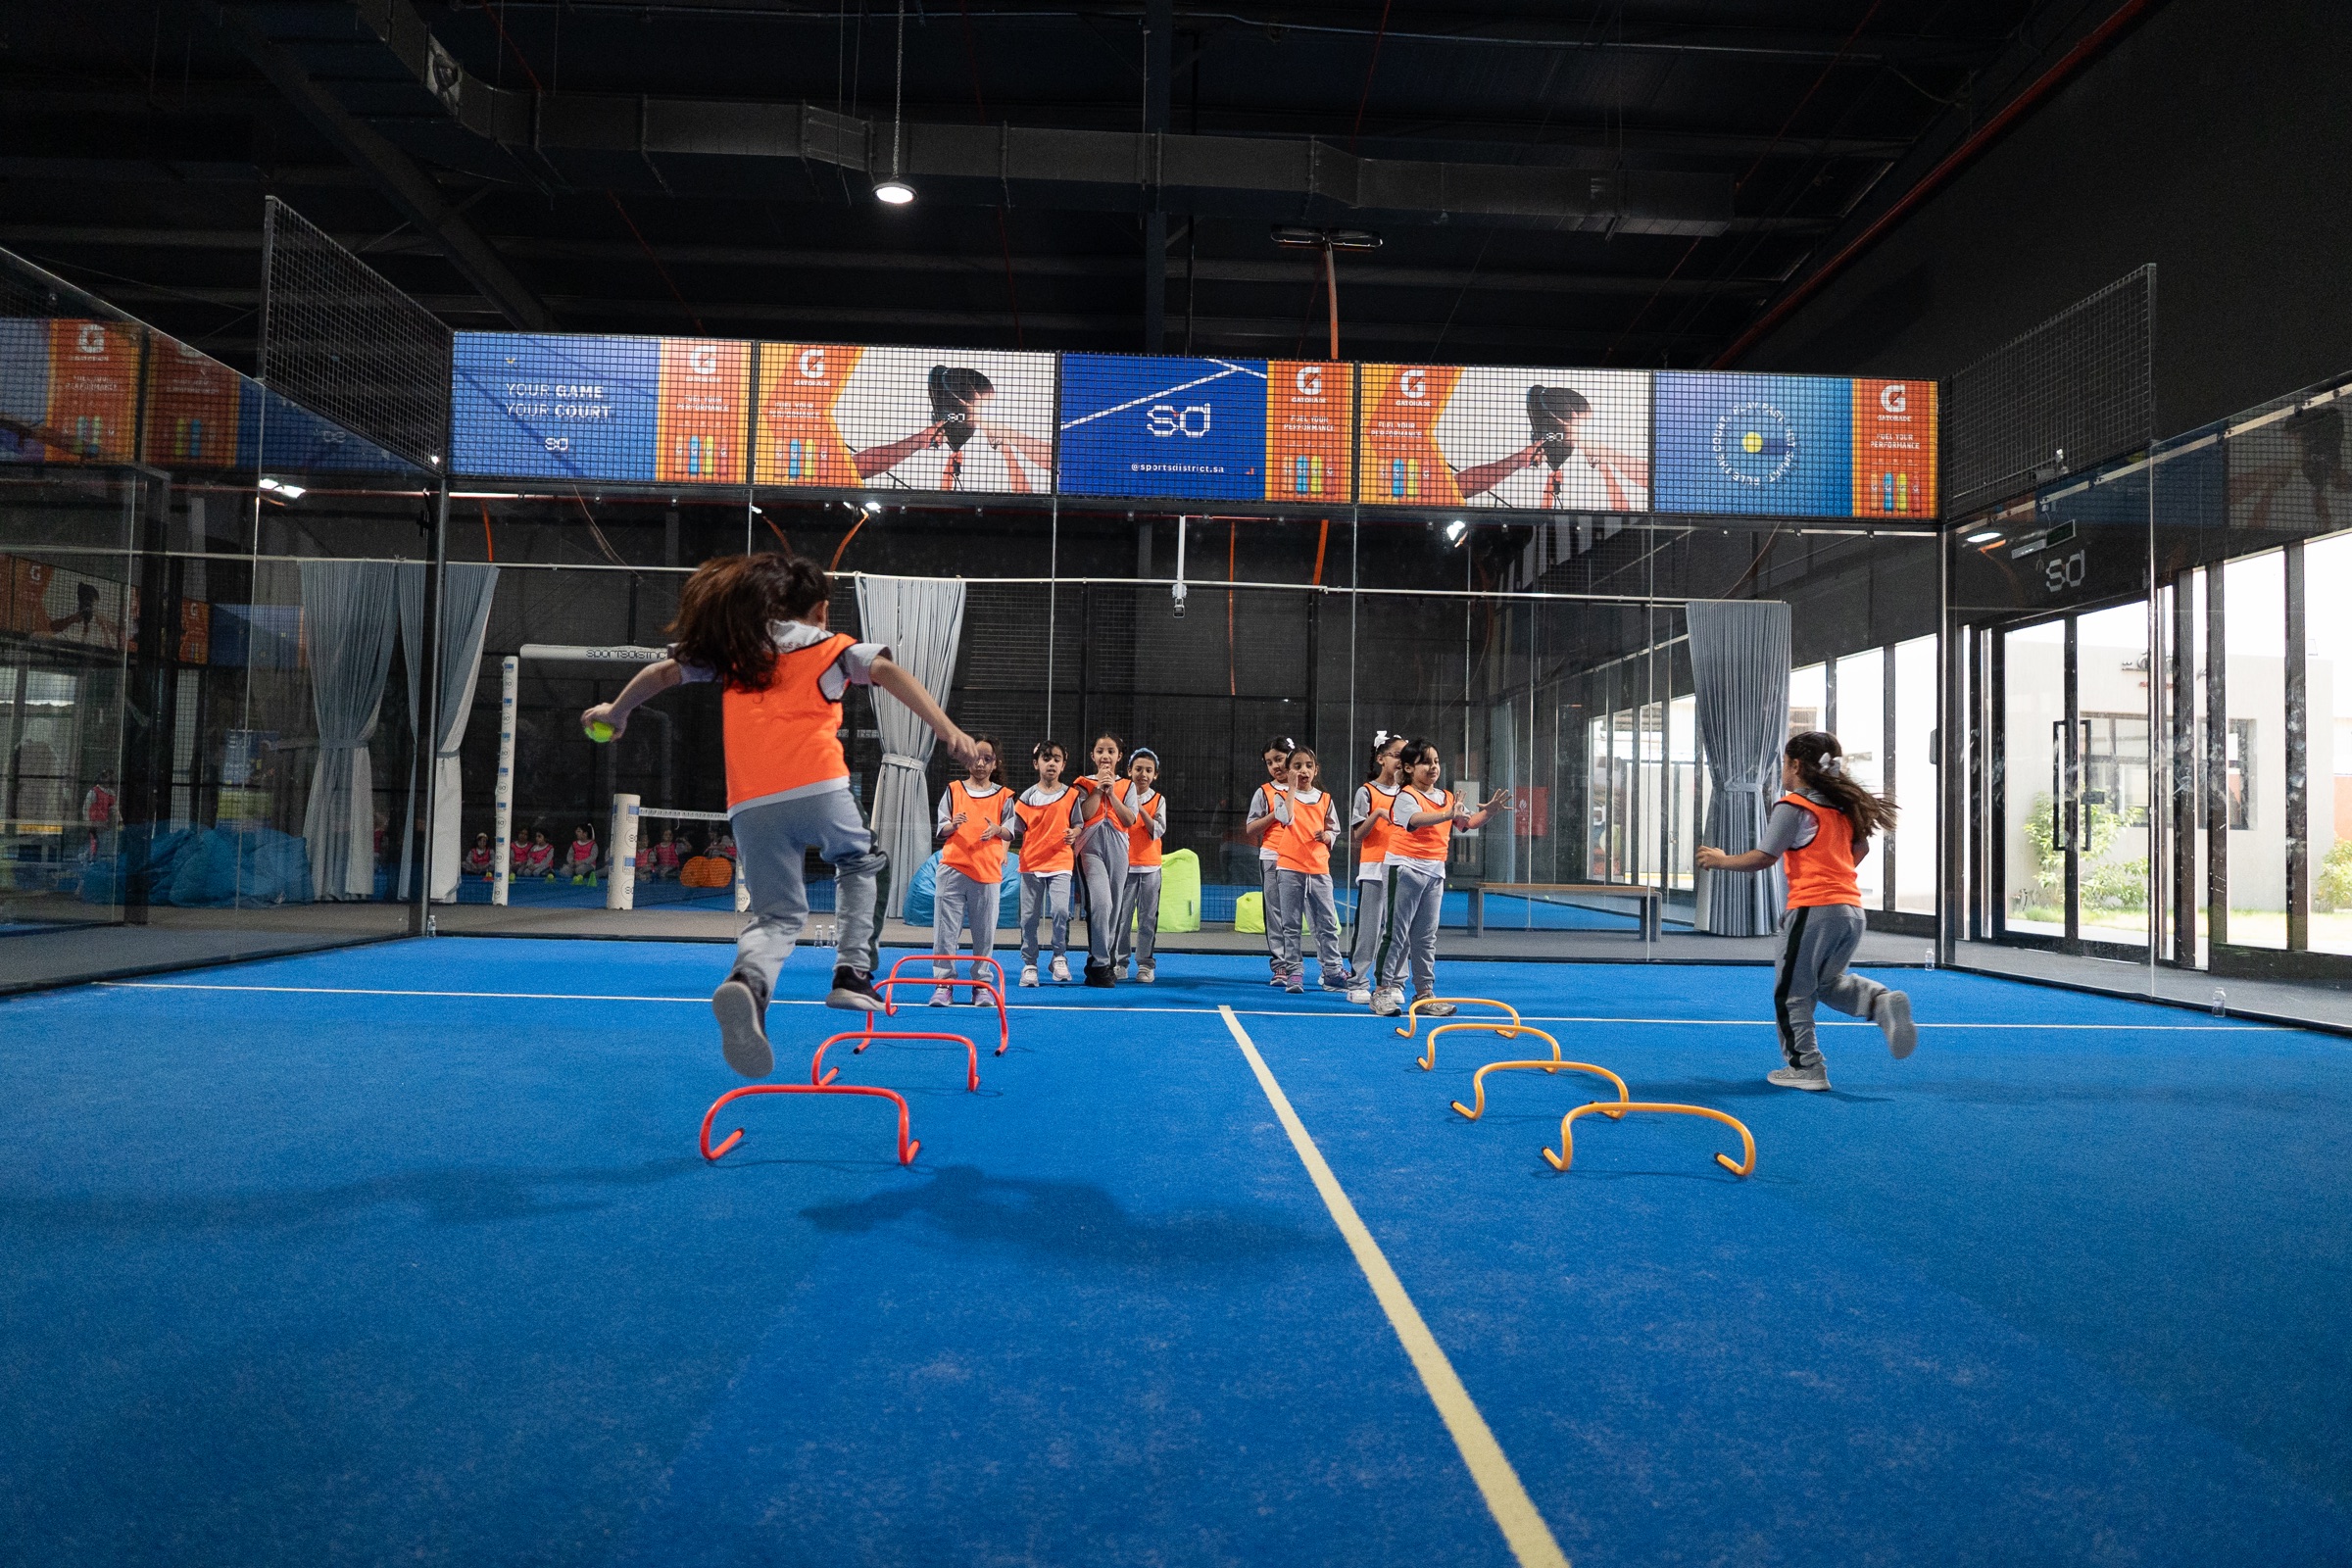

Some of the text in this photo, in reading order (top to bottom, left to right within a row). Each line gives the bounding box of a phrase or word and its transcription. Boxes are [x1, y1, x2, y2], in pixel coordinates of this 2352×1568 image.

[690, 345, 716, 375] G
[799, 349, 825, 378] G
[1297, 367, 1322, 395] G
[1400, 369, 1425, 398] G
[505, 382, 604, 399] YOUR GAME
[684, 394, 702, 403] FUEL
[1881, 384, 1906, 413] G
[505, 403, 611, 418] YOUR COURT
[677, 403, 729, 413] PERFORMANCE
[768, 410, 820, 418] PERFORMANCE
[1733, 402, 1758, 415] PLAY
[1284, 423, 1335, 432] PERFORMANCE
[1371, 429, 1422, 438] PERFORMANCE
[1786, 428, 1796, 448] HIT
[1131, 463, 1225, 474] @sportsdistrict.sa
[1716, 454, 1732, 474] THE
[1732, 471, 1761, 485] RULE
